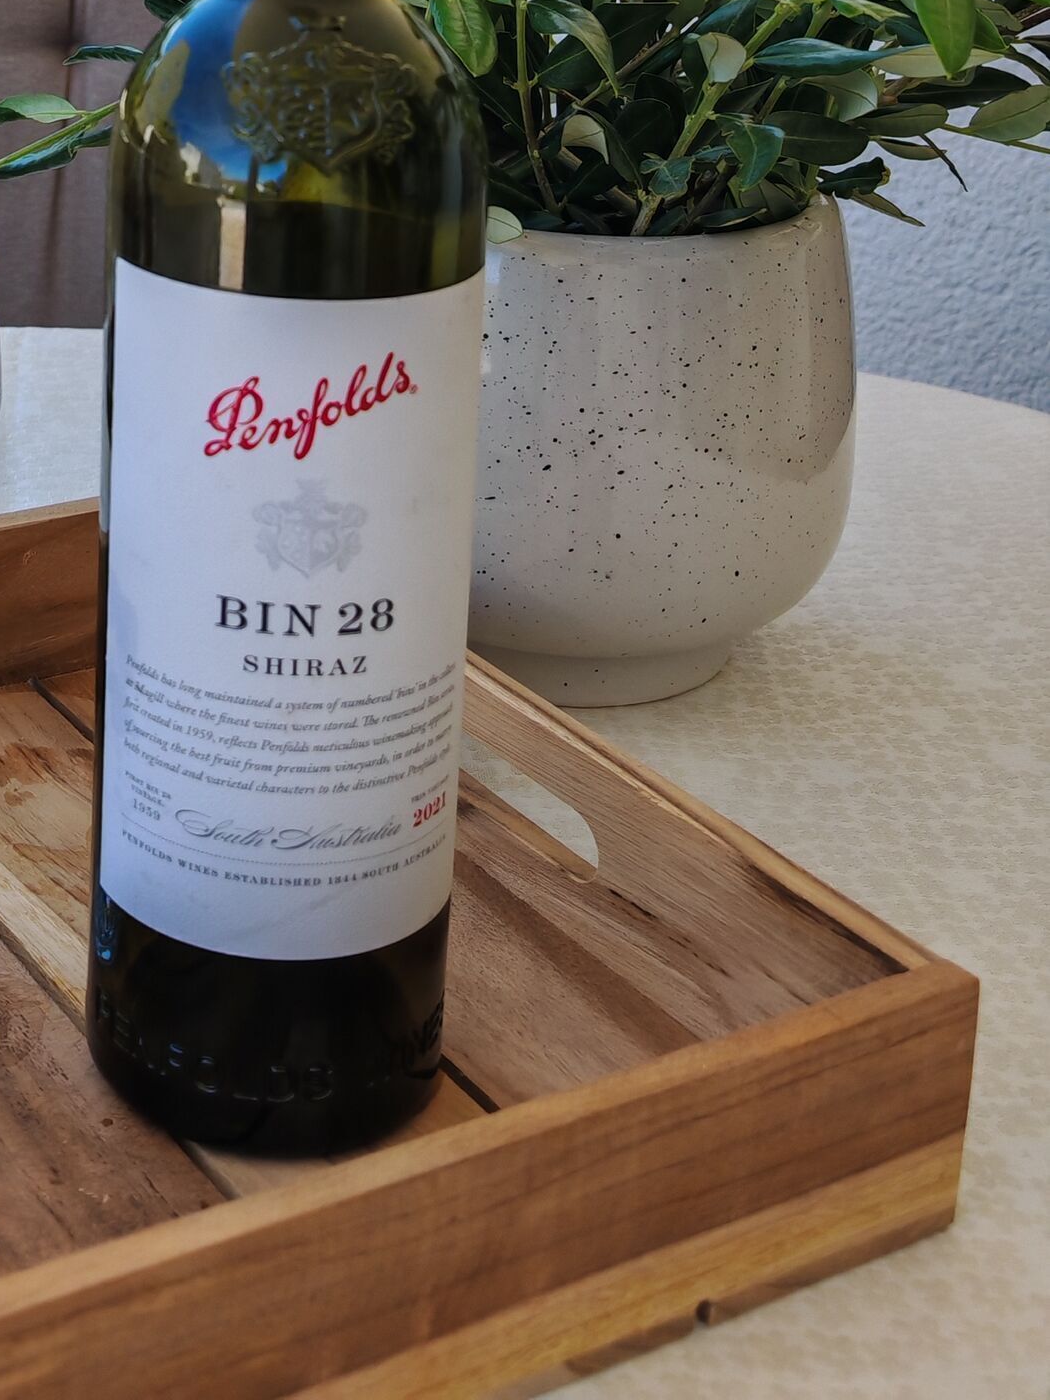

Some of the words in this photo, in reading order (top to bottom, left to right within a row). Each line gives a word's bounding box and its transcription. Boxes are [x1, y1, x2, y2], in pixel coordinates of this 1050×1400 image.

[204, 352, 410, 460] Penfolds
[215, 594, 322, 637] BIN
[337, 598, 394, 636] 28
[126, 654, 160, 681] Penfolds
[160, 673, 177, 688] has
[178, 680, 202, 700] long
[203, 690, 274, 709] maintained
[274, 701, 283, 709] a
[284, 701, 324, 714] system
[325, 698, 342, 713] of
[340, 690, 395, 709] numbered
[242, 654, 367, 676] SHIRAZ
[139, 708, 172, 729] created
[172, 720, 184, 731] in
[185, 724, 216, 743] 1959,
[218, 736, 258, 750] reflects
[260, 738, 310, 756] Penfolds
[311, 738, 371, 753] meticulous
[372, 721, 428, 747] winemaking
[165, 700, 197, 716] where
[198, 708, 217, 721] the
[214, 712, 251, 727] finest
[252, 719, 288, 731] wines
[290, 723, 321, 731] were
[361, 715, 381, 727] The
[141, 751, 182, 774] regional
[181, 770, 205, 782] and
[205, 775, 255, 792] varietal
[255, 781, 315, 795] characters
[317, 784, 330, 795] to
[332, 782, 351, 794] the
[352, 771, 406, 791] distinctive
[170, 742, 188, 755] the
[188, 747, 211, 762] best
[209, 753, 242, 768] fruit
[239, 758, 273, 773] from
[273, 762, 331, 777] premium
[333, 753, 390, 774] vineyards,
[392, 750, 403, 761] in
[132, 798, 162, 822] 1959
[174, 808, 275, 848] South
[270, 815, 403, 851] Australia
[411, 790, 447, 829] 2021
[121, 828, 173, 864] PENFOLDS
[177, 857, 219, 878] WINES
[224, 870, 322, 887] ESTABLISHED
[328, 874, 358, 885] 1844
[360, 861, 400, 879] SOUTH
[97, 983, 335, 1104] PEFODS
